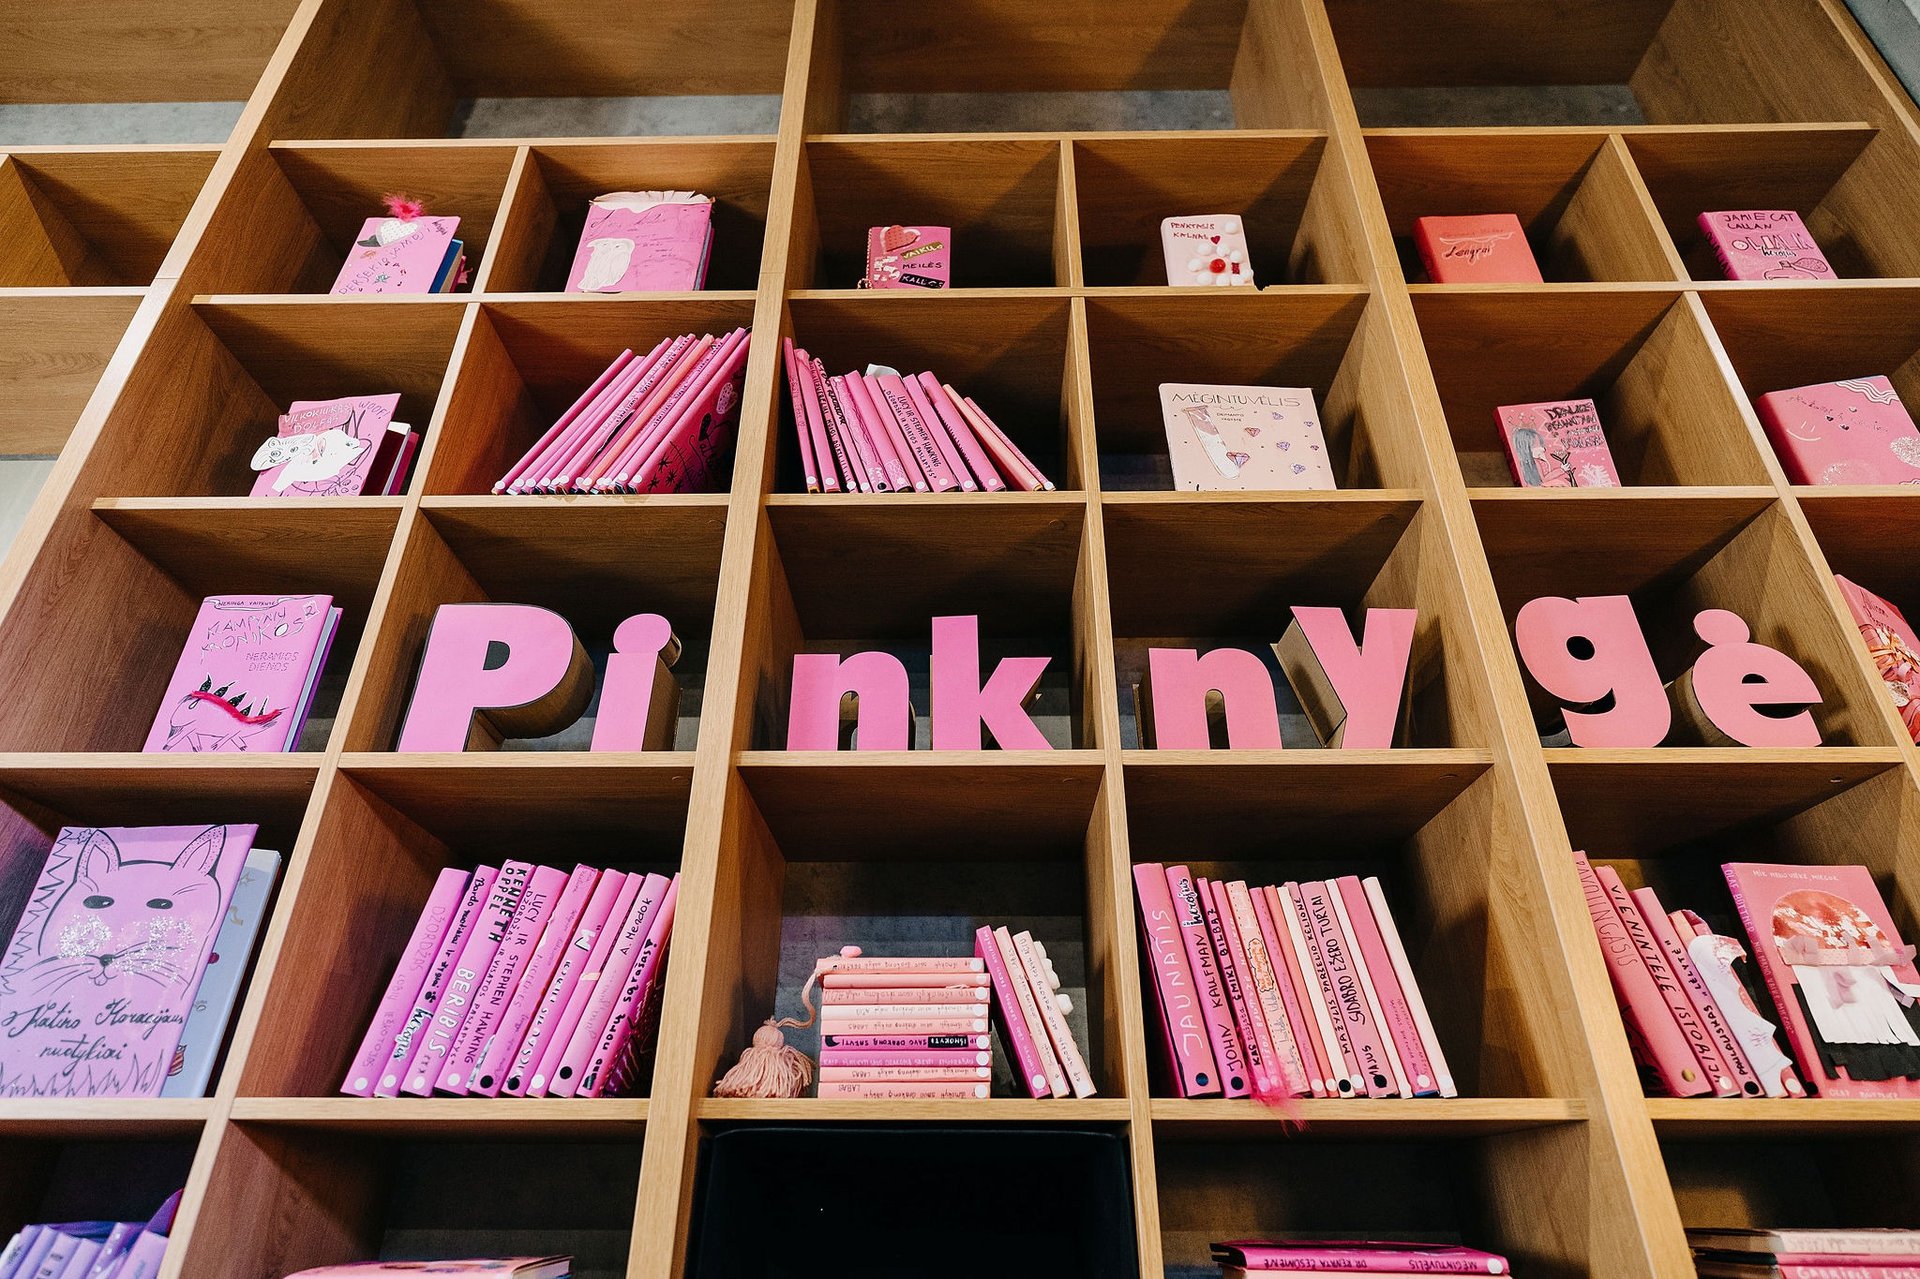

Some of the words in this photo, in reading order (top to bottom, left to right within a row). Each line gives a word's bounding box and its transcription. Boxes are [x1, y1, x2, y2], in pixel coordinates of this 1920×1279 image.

[1723, 212, 1766, 222] JAMIE
[1770, 212, 1794, 222] CAT
[1171, 391, 1301, 408] MĖGINTUVĖLIS
[305, 605, 316, 616] 2
[245, 651, 300, 662] NERAMIOS
[248, 662, 290, 672] DIENOS
[488, 867, 515, 910] OPPEL
[488, 868, 528, 944] KENNETH
[527, 891, 547, 923] LUCY
[1309, 894, 1334, 938] TURTAI
[514, 932, 529, 946] IR
[1326, 937, 1347, 973] EŽERO
[1610, 884, 1681, 994] VIENINTELĖ
[490, 954, 520, 1006] STEPHEN
[1151, 908, 1204, 1057] JAUNATIS
[1193, 932, 1223, 1009] KAUFMAN
[428, 966, 477, 1058] BERIBIS
[1337, 974, 1367, 1026] SIDABRO
[39, 1033, 128, 1077] nuotykiai
[463, 1011, 494, 1064] HAWKING
[1217, 1022, 1243, 1072] JOHN
[1247, 1043, 1261, 1066] KAS
[1702, 1004, 1748, 1076] PAULAUSKAS
[1354, 1259, 1368, 1270] DR
